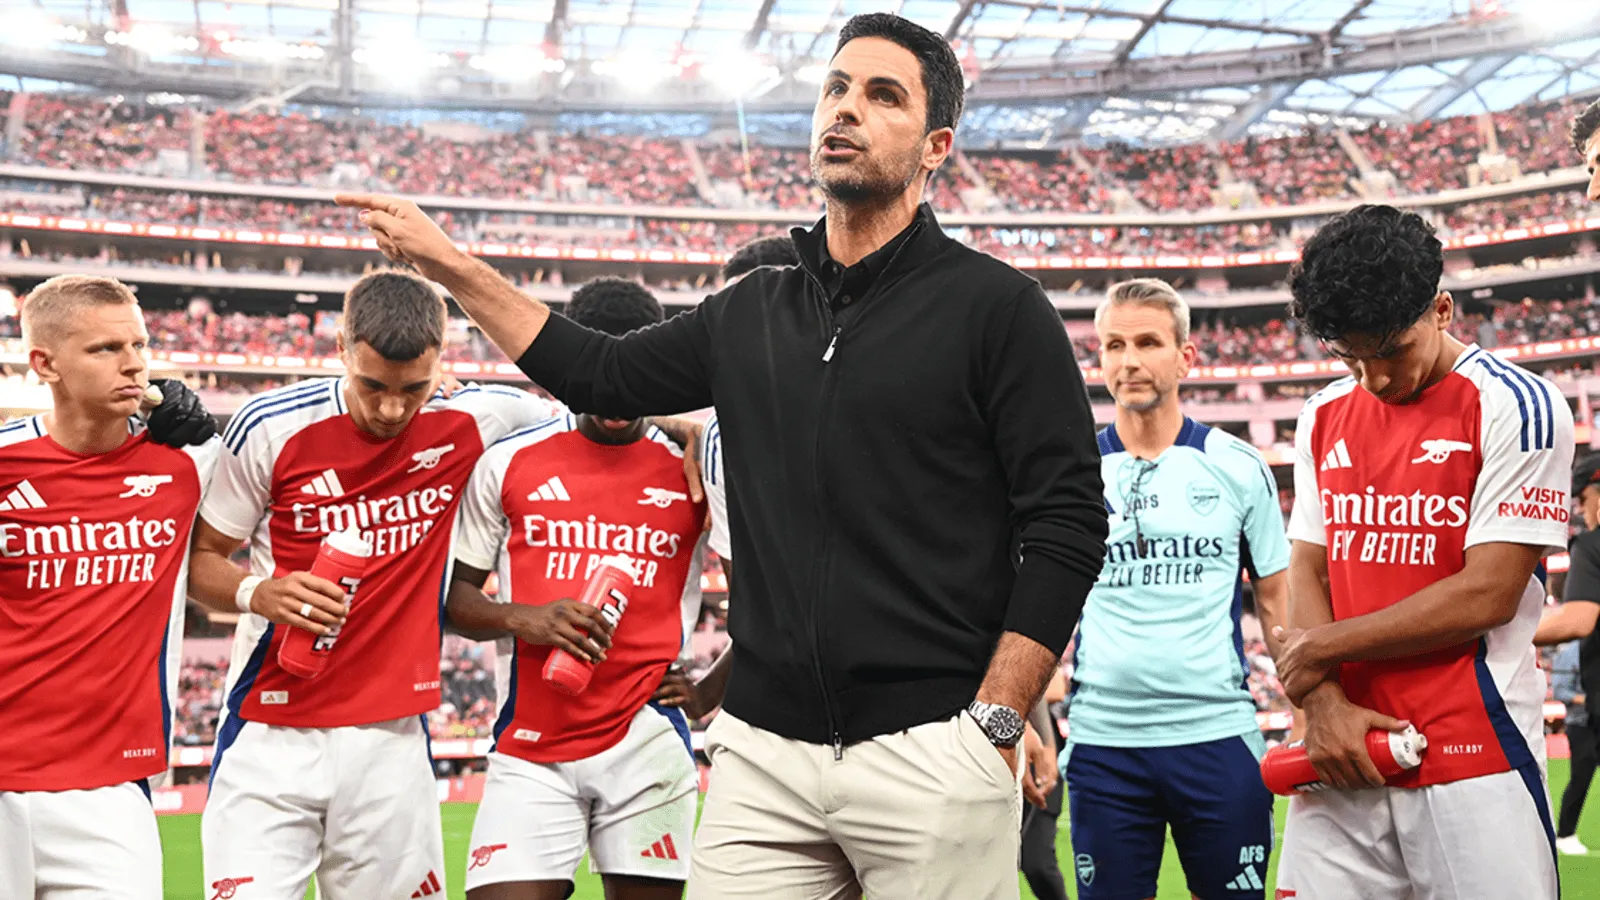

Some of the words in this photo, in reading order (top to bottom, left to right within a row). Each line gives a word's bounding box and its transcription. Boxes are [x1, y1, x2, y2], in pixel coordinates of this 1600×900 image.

[293, 484, 453, 534] Emirates
[1320, 485, 1468, 528] Emirates
[1497, 501, 1569, 523] RWAND
[1521, 486, 1566, 506] VISIT
[0, 516, 176, 558] Emirates
[523, 515, 681, 559] Emirates
[1107, 533, 1223, 564] mrates
[1332, 530, 1356, 562] FY
[1360, 531, 1437, 566] BETTER
[27, 558, 66, 590] FLY
[75, 553, 156, 587] BETTER
[545, 551, 581, 580] FLY
[1108, 566, 1135, 588] FLY
[1142, 562, 1204, 586] BETTER
[1239, 844, 1265, 865] AFS
